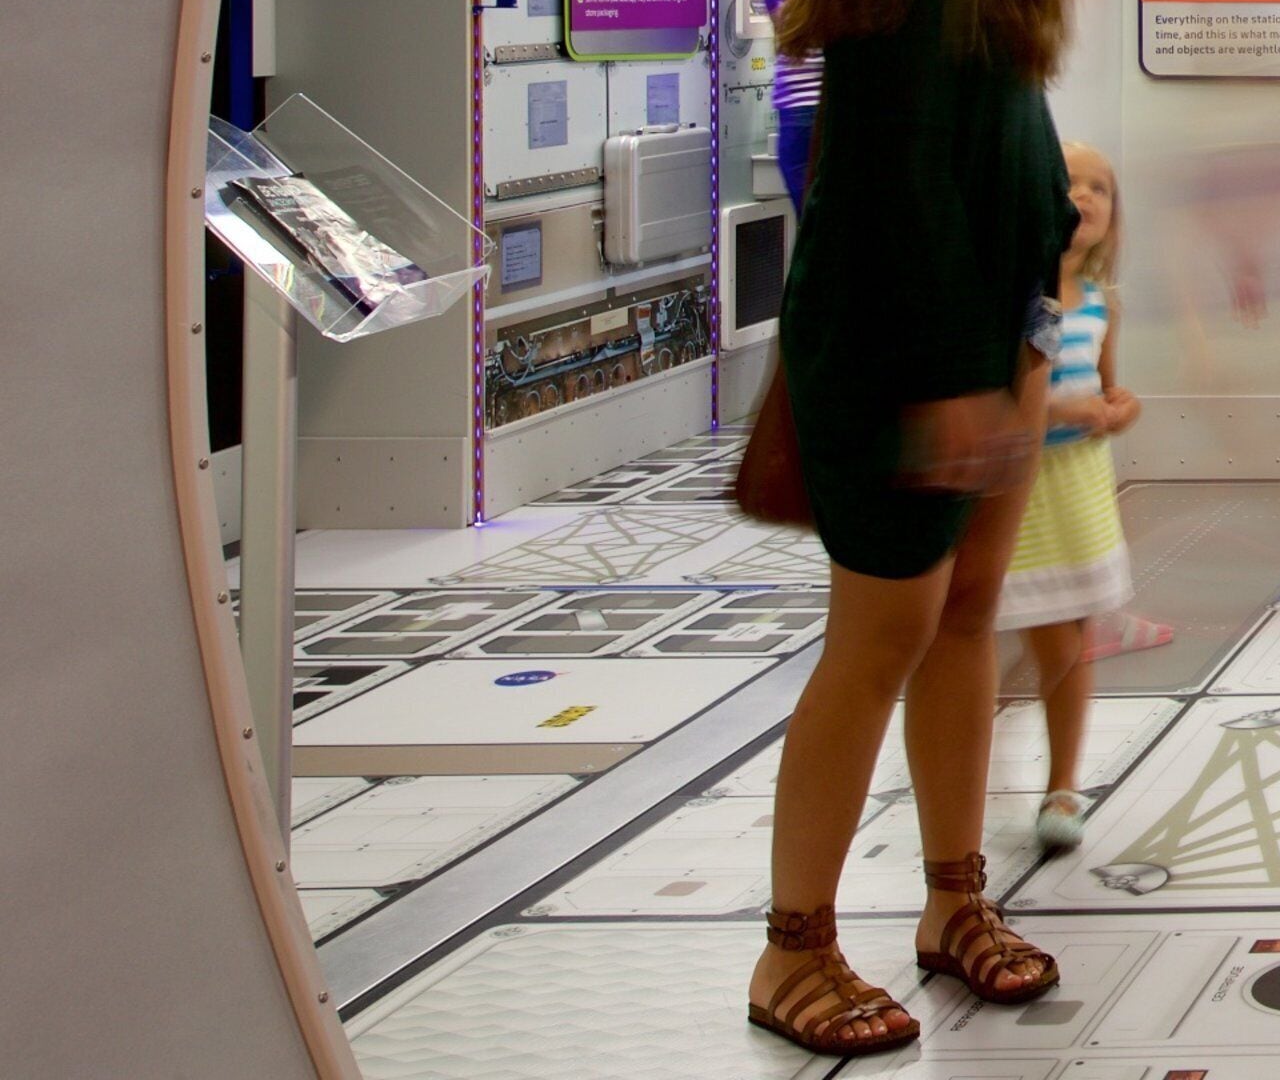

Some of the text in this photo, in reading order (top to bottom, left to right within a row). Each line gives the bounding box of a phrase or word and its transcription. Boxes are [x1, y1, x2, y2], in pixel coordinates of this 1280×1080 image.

[1156, 15, 1212, 27] Everything
[1231, 15, 1248, 24] the
[1156, 29, 1181, 40] time,
[1184, 29, 1203, 39] and
[1206, 29, 1226, 39] this
[1229, 29, 1237, 39] is
[1240, 29, 1266, 39] what
[1155, 44, 1174, 54] and
[1177, 44, 1215, 56] objects
[1218, 46, 1234, 54] are
